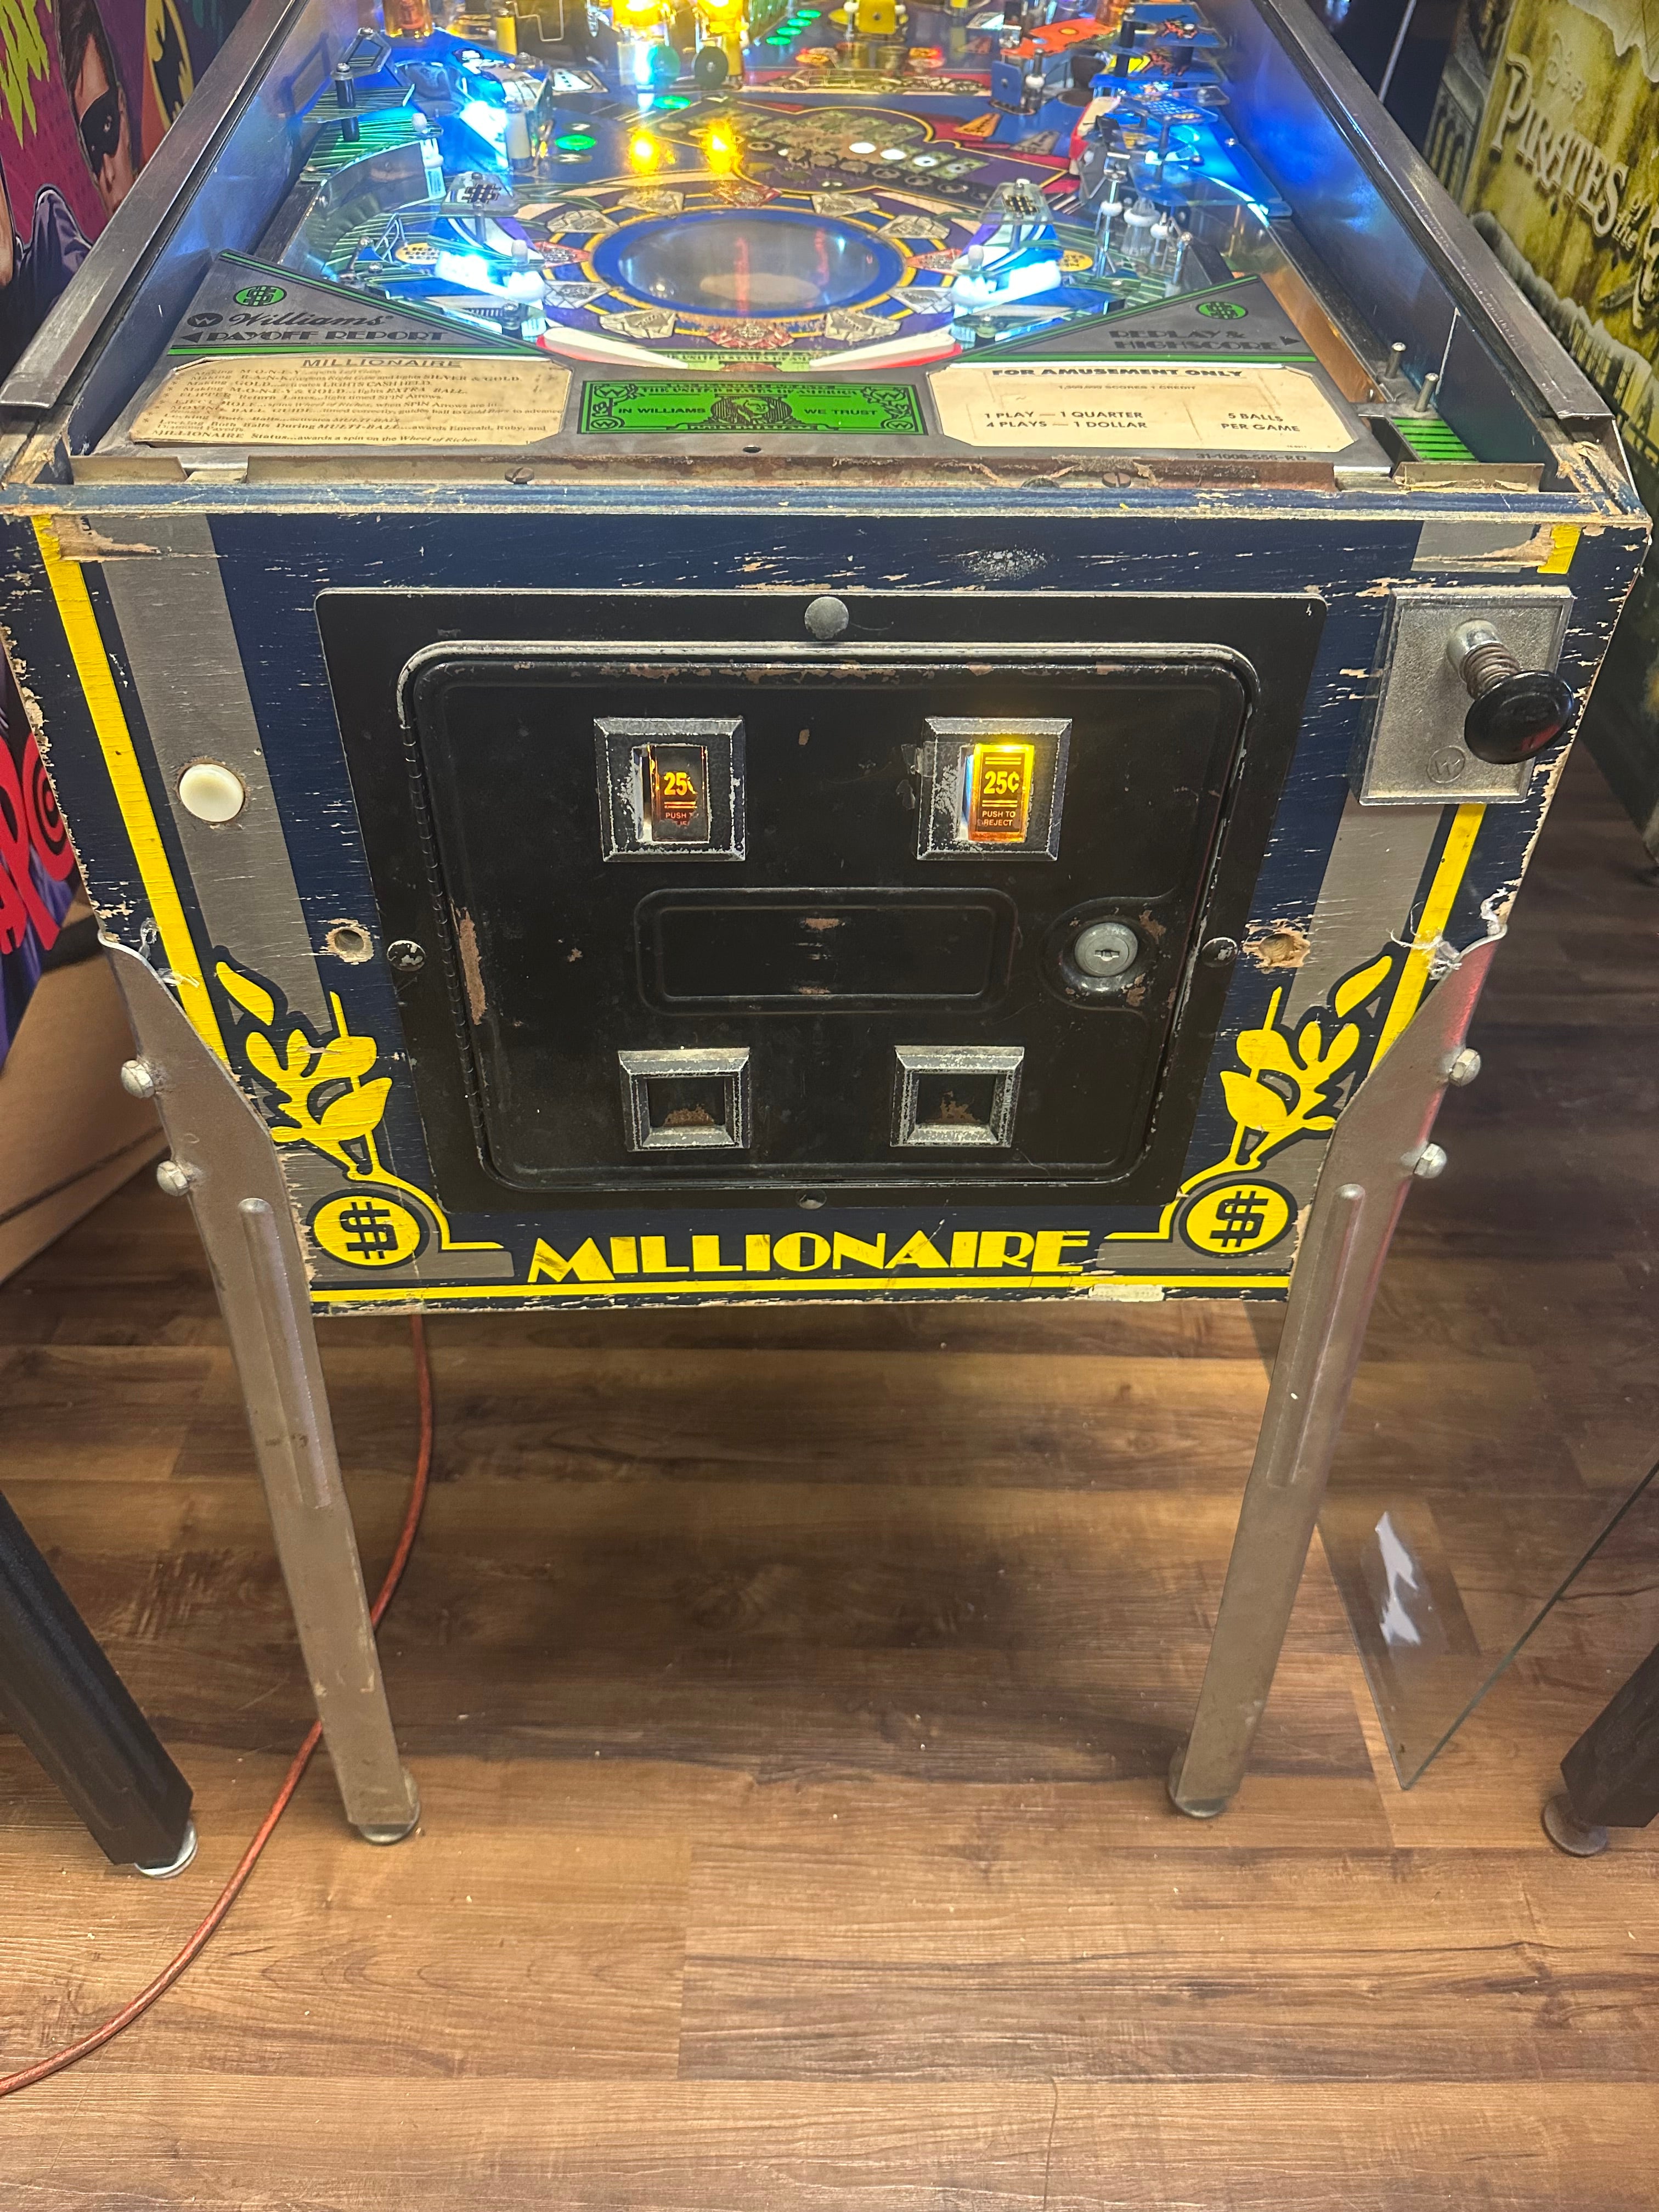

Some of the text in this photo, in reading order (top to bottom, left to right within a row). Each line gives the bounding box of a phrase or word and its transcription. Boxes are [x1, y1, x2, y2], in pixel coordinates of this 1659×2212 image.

[1491, 53, 1629, 238] PIRATES
[1611, 210, 1639, 251] the
[206, 331, 448, 341] PAYOFF REPORT
[1109, 330, 1221, 338] REPLAY
[302, 359, 463, 367] MILLIONAIRE
[1240, 413, 1284, 422] BALLS
[983, 771, 1020, 794] 25¢
[527, 1229, 1091, 1283] MILLIONAIRE
